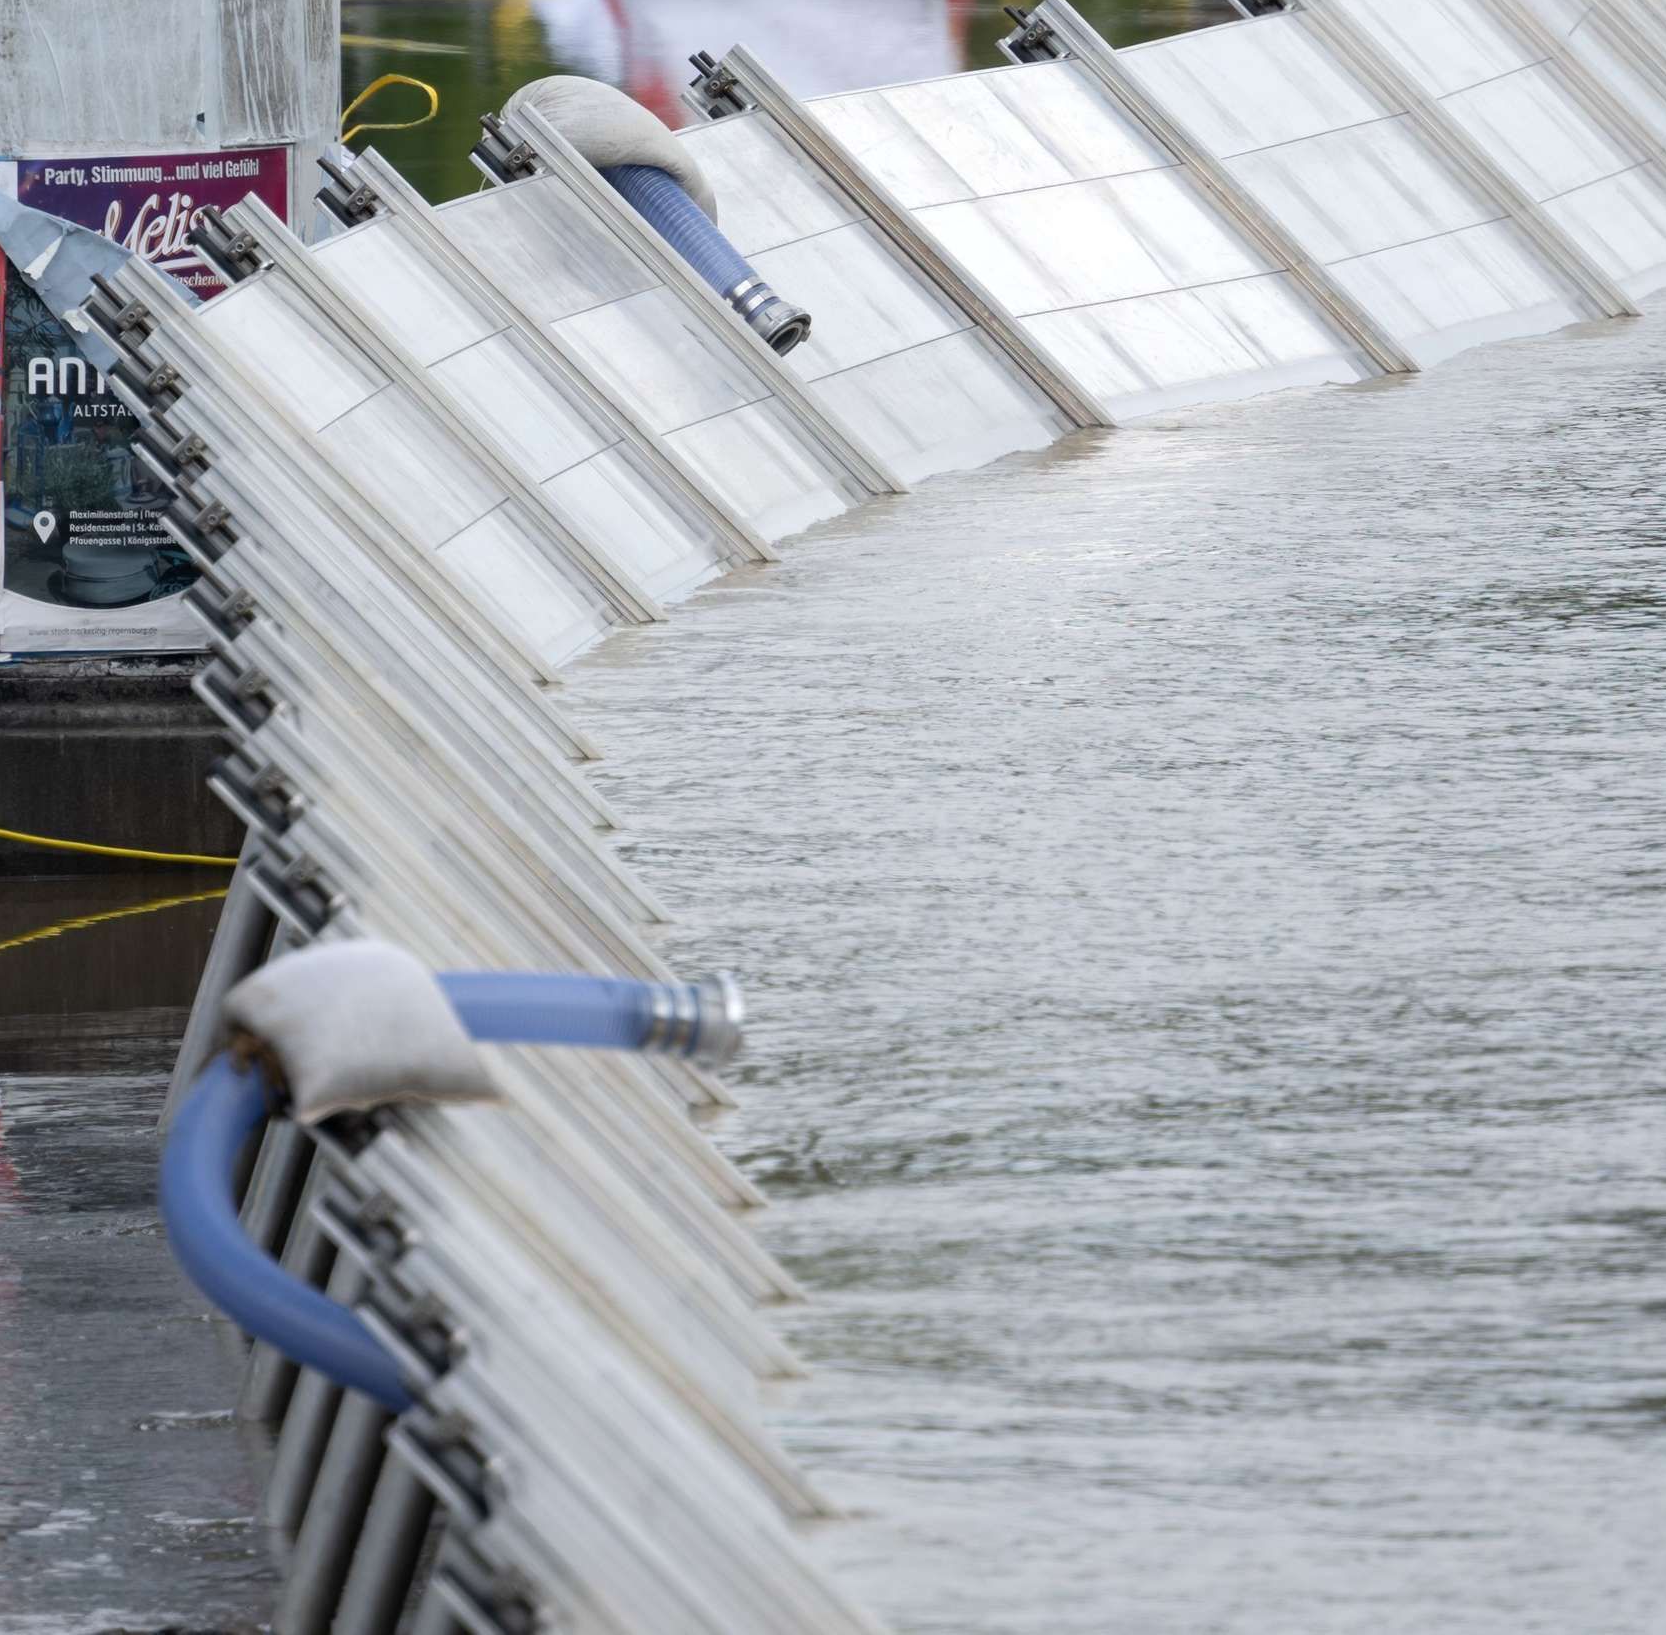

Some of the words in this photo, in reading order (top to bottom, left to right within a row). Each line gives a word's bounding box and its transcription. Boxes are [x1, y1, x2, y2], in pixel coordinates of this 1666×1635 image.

[44, 167, 89, 186] Party,
[202, 161, 222, 178] viel
[225, 158, 259, 178] Gefühl
[69, 510, 139, 520] Maximilianstraße
[69, 523, 131, 533] Residenzstraße
[69, 537, 122, 547] Pfauengasse
